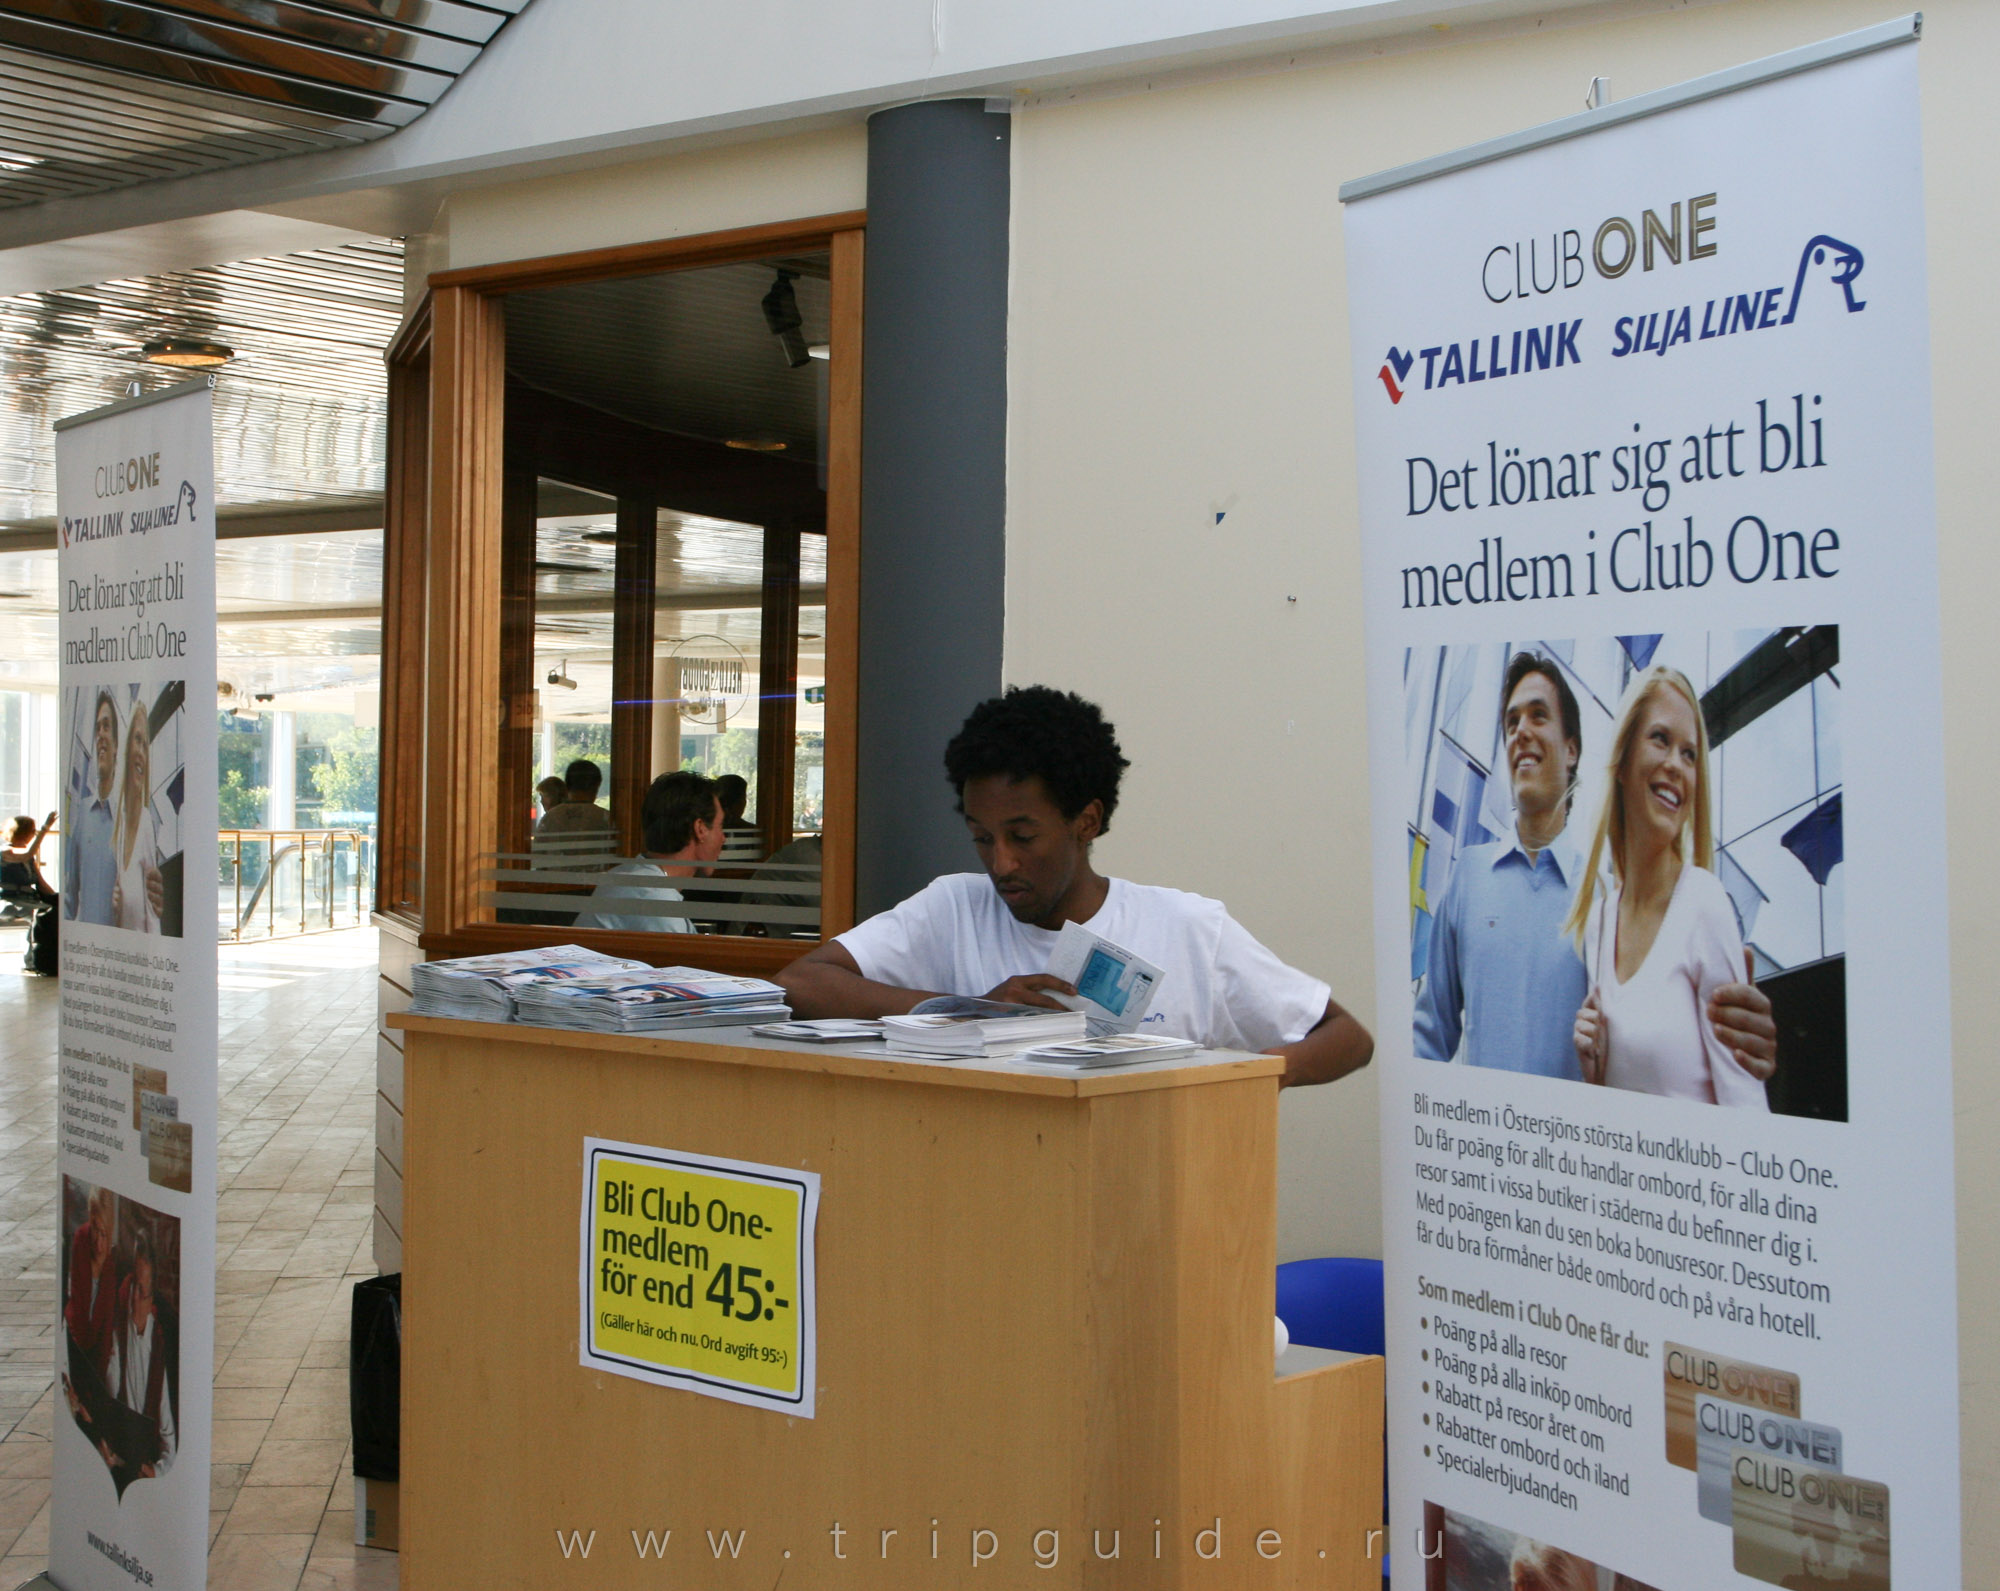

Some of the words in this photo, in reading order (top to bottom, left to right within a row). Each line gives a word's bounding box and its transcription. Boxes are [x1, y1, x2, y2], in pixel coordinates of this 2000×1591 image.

[1419, 318, 1583, 390] TALLINK
[1612, 305, 1691, 357] SILJA
[1699, 287, 1784, 340] LINE
[1406, 454, 1477, 516] Det
[1487, 440, 1600, 508] lönar
[1611, 422, 1671, 512] sig
[1680, 419, 1744, 483] att
[1756, 393, 1826, 474] bli
[74, 511, 123, 542] TALLINK
[130, 508, 152, 534] SILJA
[153, 505, 175, 528] LINE
[1401, 536, 1575, 609] medlem
[1587, 530, 1599, 595] i
[1609, 516, 1713, 593] Club
[1727, 515, 1839, 584] One
[68, 579, 91, 613] Det
[94, 573, 127, 610] lönar
[129, 569, 144, 618] sig
[146, 573, 162, 603] att
[165, 561, 184, 601] bli
[65, 627, 118, 665] medlem
[121, 626, 125, 662] i
[127, 622, 153, 661] Club
[156, 621, 187, 657] One
[1414, 1092, 1429, 1116] Bli
[1432, 1099, 1491, 1126] medlem
[1495, 1107, 1499, 1127] i
[1503, 1104, 1580, 1143] Östersjöns
[1584, 1125, 1633, 1153] största
[1637, 1131, 1722, 1170] kundklubb
[1741, 1151, 1784, 1180] Club
[1789, 1158, 1838, 1189] One.
[1415, 1125, 1432, 1148] Du
[1436, 1128, 1454, 1152] får
[1458, 1137, 1504, 1167] poäng
[1507, 1140, 1529, 1166] för
[1532, 1146, 1555, 1172] allt
[1558, 1151, 1577, 1176] du
[1581, 1154, 1634, 1188] handlar
[1638, 1171, 1706, 1207] ombord,
[1710, 1181, 1735, 1209] för
[1739, 1188, 1769, 1216] alla
[1775, 1193, 1817, 1224] dina
[602, 1226, 709, 1271] medlem
[604, 1180, 634, 1217] Bli
[641, 1187, 700, 1228] Club
[706, 1199, 773, 1240] One-
[1416, 1162, 1448, 1184] resor
[1451, 1169, 1487, 1192] samt
[1490, 1172, 1495, 1193] i
[1498, 1176, 1533, 1201] vissa
[1537, 1179, 1588, 1213] butiker
[1592, 1193, 1596, 1214] i
[1600, 1198, 1663, 1231] städerna
[1667, 1210, 1688, 1237] du
[1693, 1213, 1766, 1253] befinner
[1771, 1231, 1802, 1267] dig
[1807, 1238, 1818, 1263] i.
[1416, 1190, 1444, 1215] Med
[1448, 1201, 1511, 1232] poängen
[1515, 1209, 1541, 1237] kan
[1545, 1216, 1564, 1242] du
[1568, 1227, 1592, 1249] sen
[1596, 1227, 1632, 1259] boka
[1636, 1237, 1728, 1283] bonusresor.
[1732, 1261, 1830, 1304] Dessutom
[601, 1258, 637, 1297] för
[643, 1274, 694, 1309] end
[705, 1262, 789, 1322] 45:-
[1417, 1220, 1433, 1244] får
[1436, 1226, 1454, 1250] du
[1458, 1230, 1481, 1257] bra
[1485, 1235, 1553, 1273] förmåner
[1557, 1251, 1592, 1284] både
[1596, 1268, 1655, 1301] ombord
[1659, 1283, 1689, 1310] och
[1693, 1291, 1713, 1319] på
[1717, 1296, 1754, 1326] våra
[1760, 1303, 1821, 1340] hotell.
[1418, 1275, 1448, 1303] Som
[1452, 1289, 1515, 1322] medlem
[1518, 1300, 1524, 1322] i
[1527, 1303, 1563, 1332] Club
[1566, 1314, 1597, 1343] One
[1600, 1321, 1621, 1350] får
[1624, 1330, 1650, 1359] du:
[600, 1311, 635, 1333] (Gäller
[636, 1319, 655, 1337] här
[656, 1326, 677, 1343] och
[701, 1333, 722, 1352] Ord
[725, 1342, 759, 1361] avgift
[761, 1348, 788, 1369] 95:-)
[1434, 1315, 1477, 1352] Poäng
[1480, 1329, 1498, 1354] på
[1502, 1333, 1526, 1360] alla
[1530, 1346, 1568, 1372] resor
[1435, 1347, 1478, 1385] Poäng
[1481, 1363, 1498, 1388] på
[1502, 1367, 1527, 1393] alla
[1530, 1374, 1571, 1412] inköp
[1575, 1393, 1633, 1429] ombord
[1435, 1379, 1483, 1414] Rabatt
[1485, 1397, 1503, 1422] på
[1507, 1405, 1545, 1432] resor
[1548, 1413, 1577, 1443] året
[1580, 1428, 1605, 1453] om
[1436, 1412, 1497, 1450] Rabatter
[1501, 1438, 1559, 1471] ombord
[1564, 1456, 1591, 1483] och
[1595, 1463, 1630, 1497] iland
[1437, 1444, 1578, 1511] Specialerbjudanden
